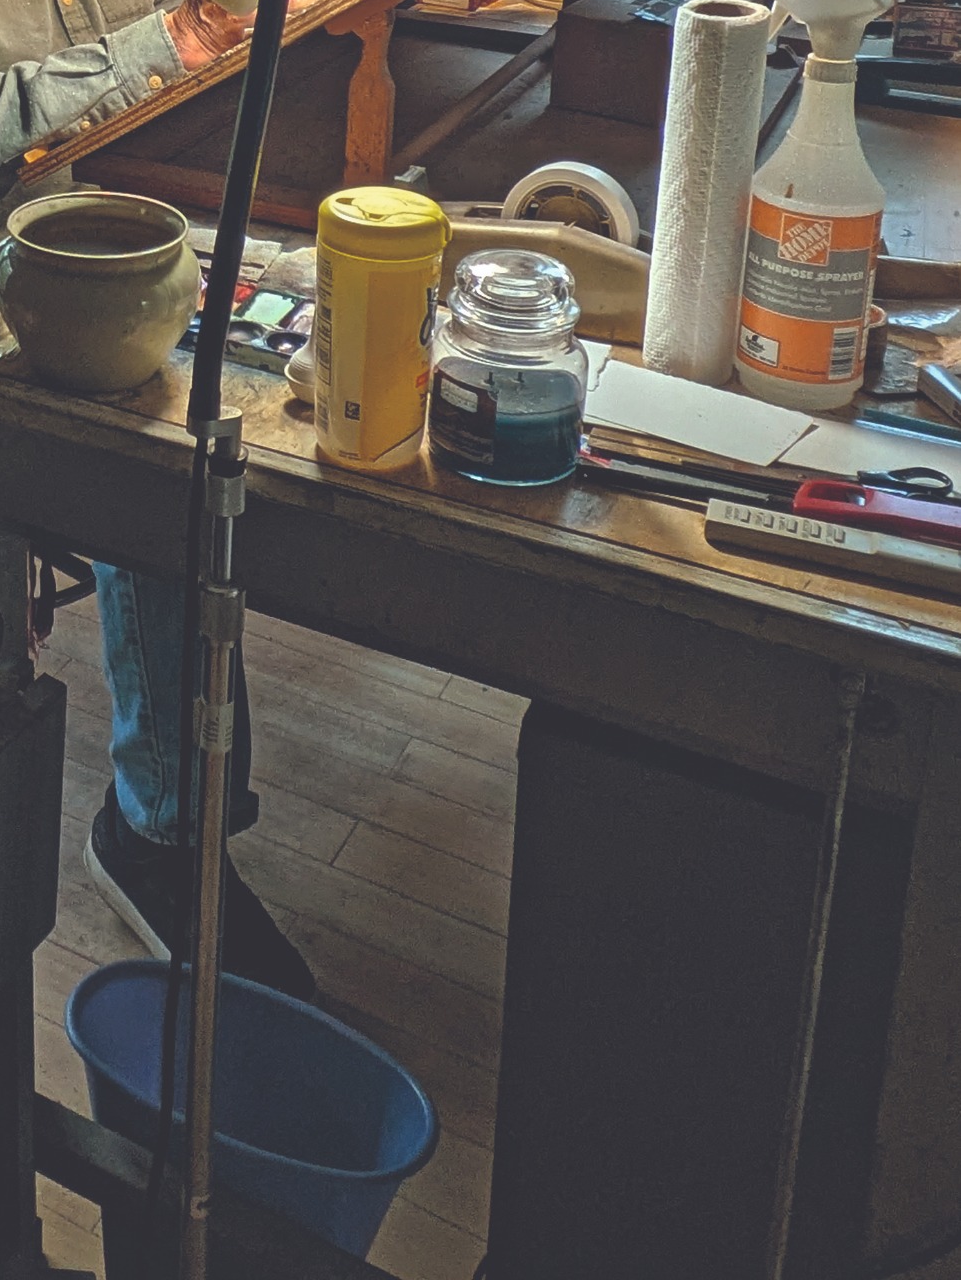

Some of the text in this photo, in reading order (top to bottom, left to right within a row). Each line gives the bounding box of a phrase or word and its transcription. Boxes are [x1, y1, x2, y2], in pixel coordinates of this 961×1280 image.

[779, 222, 830, 258] HOME
[786, 222, 807, 238] THE
[798, 239, 829, 262] DEPOT
[761, 259, 814, 280] PURPOSE
[815, 271, 864, 282] SPRAYER
